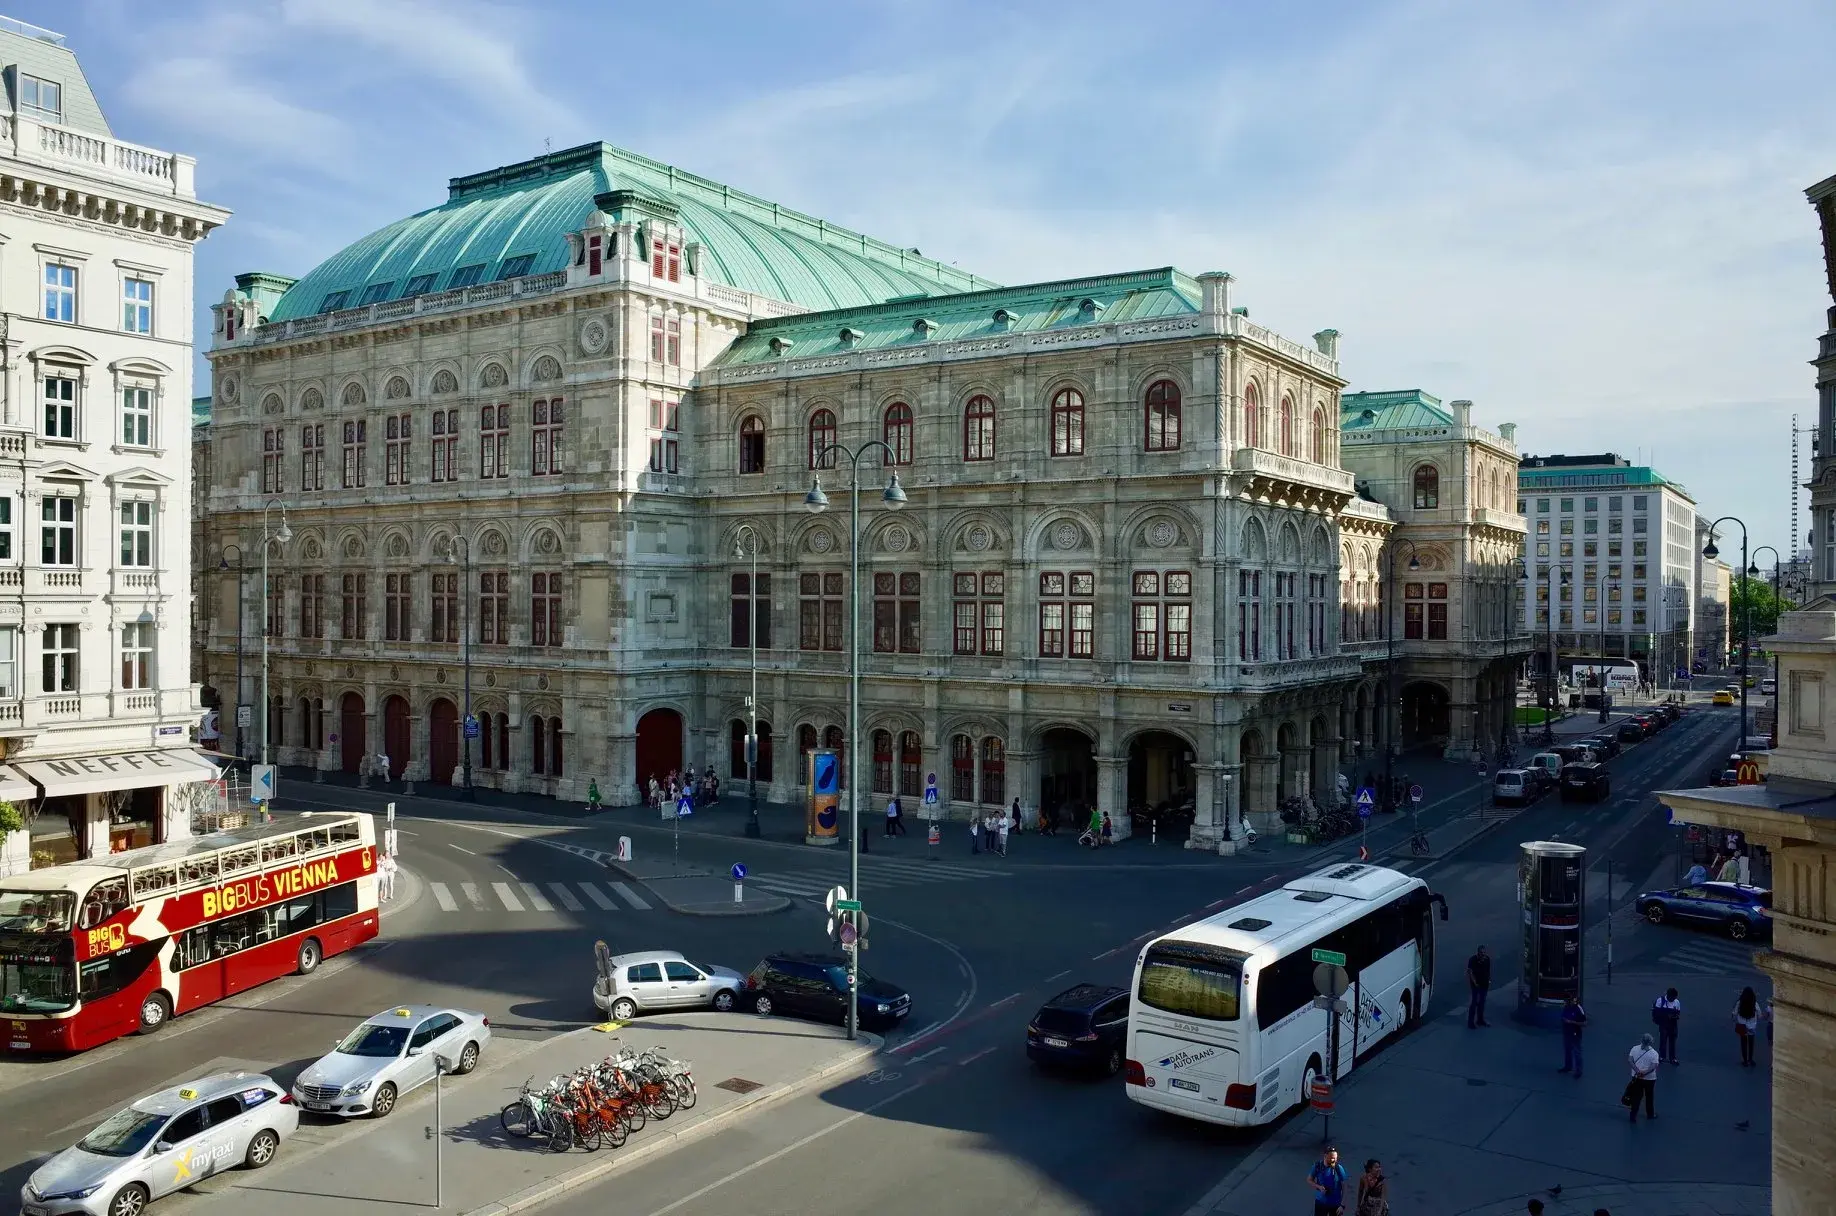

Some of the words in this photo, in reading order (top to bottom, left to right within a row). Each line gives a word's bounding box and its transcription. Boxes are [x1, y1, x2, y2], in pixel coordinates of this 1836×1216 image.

[45, 753, 172, 777] NEFFE
[273, 860, 339, 897] VIENNA
[88, 927, 109, 944] BIG
[89, 940, 110, 957] BUS
[1174, 1022, 1199, 1032] MAN
[1169, 1051, 1188, 1064] DATA
[1173, 1048, 1215, 1070] AUTOTRANS
[191, 1137, 234, 1169] mytaxi
